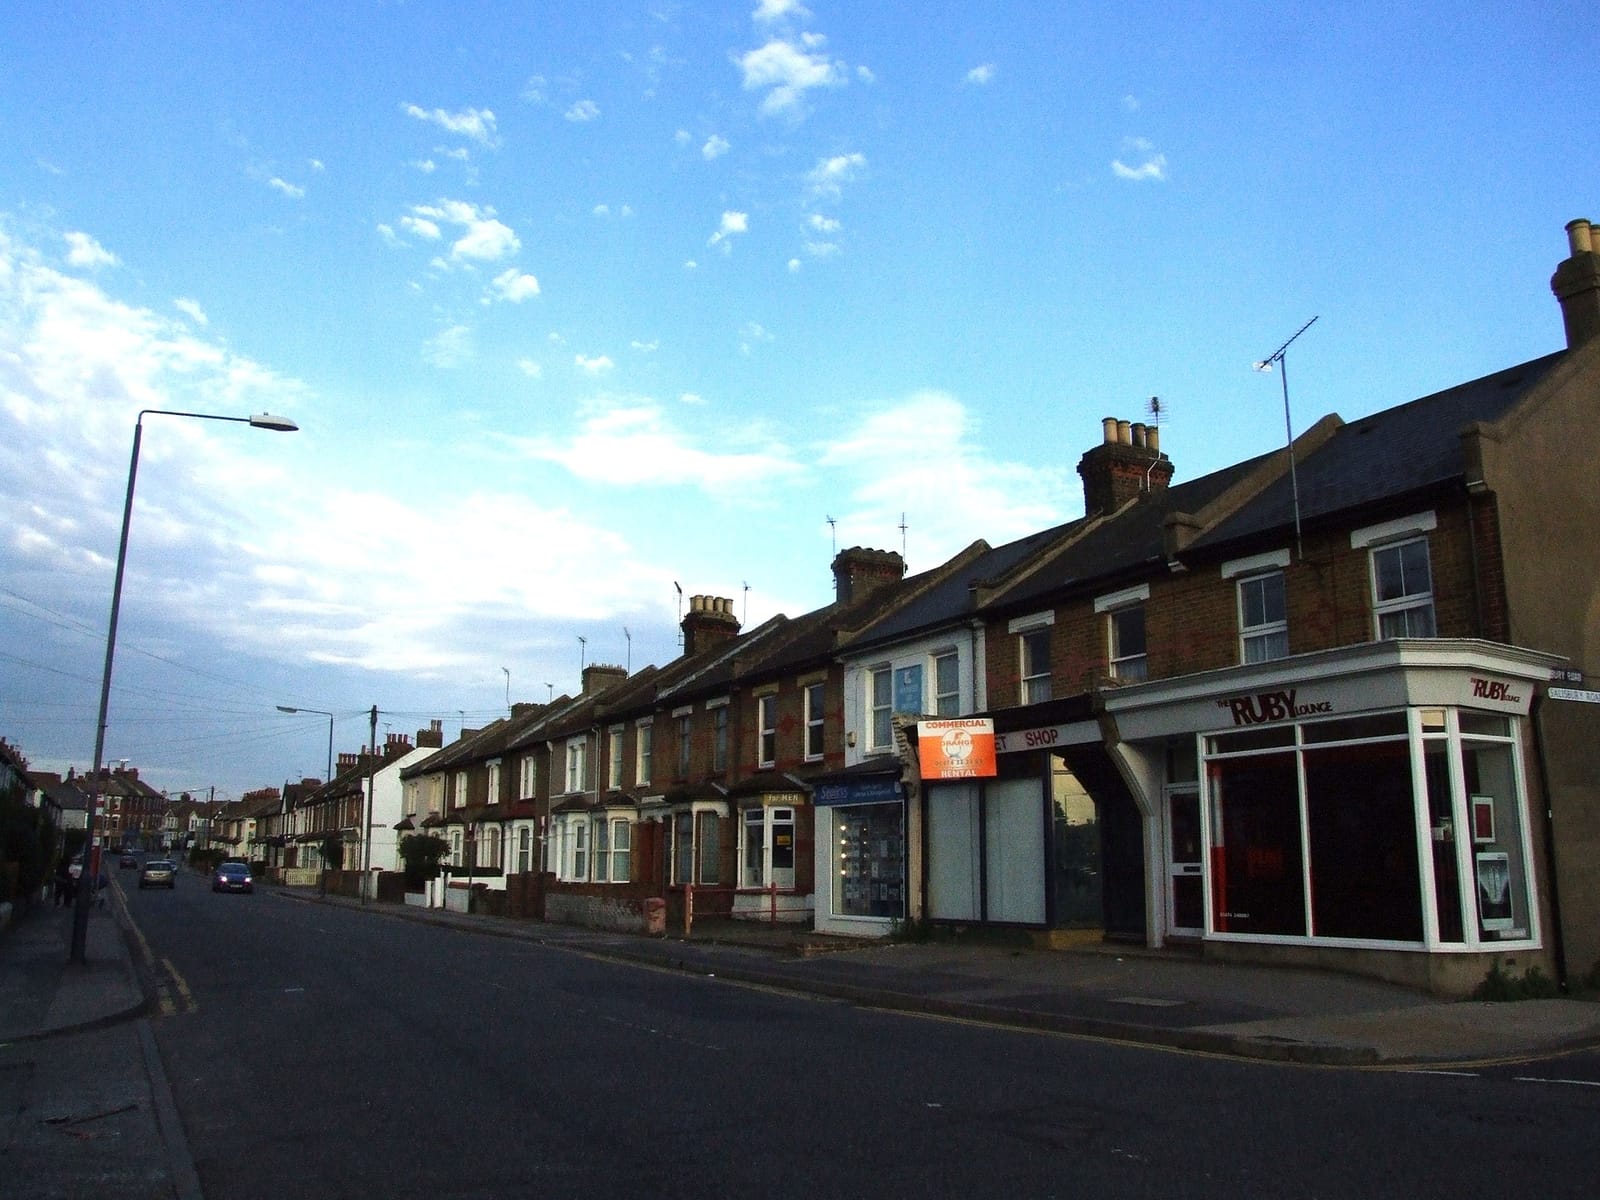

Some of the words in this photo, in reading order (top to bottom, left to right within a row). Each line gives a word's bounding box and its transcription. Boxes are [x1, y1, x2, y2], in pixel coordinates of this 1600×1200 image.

[1473, 679, 1510, 701] RUBY
[1550, 688, 1583, 701] SALISBURY
[1216, 698, 1230, 709] THE
[1230, 689, 1296, 725] RUBY
[1295, 702, 1333, 716] LOUNGE
[924, 719, 987, 729] COMMERCIAL
[1025, 728, 1058, 748] SHOP
[940, 768, 977, 779] RENTAL
